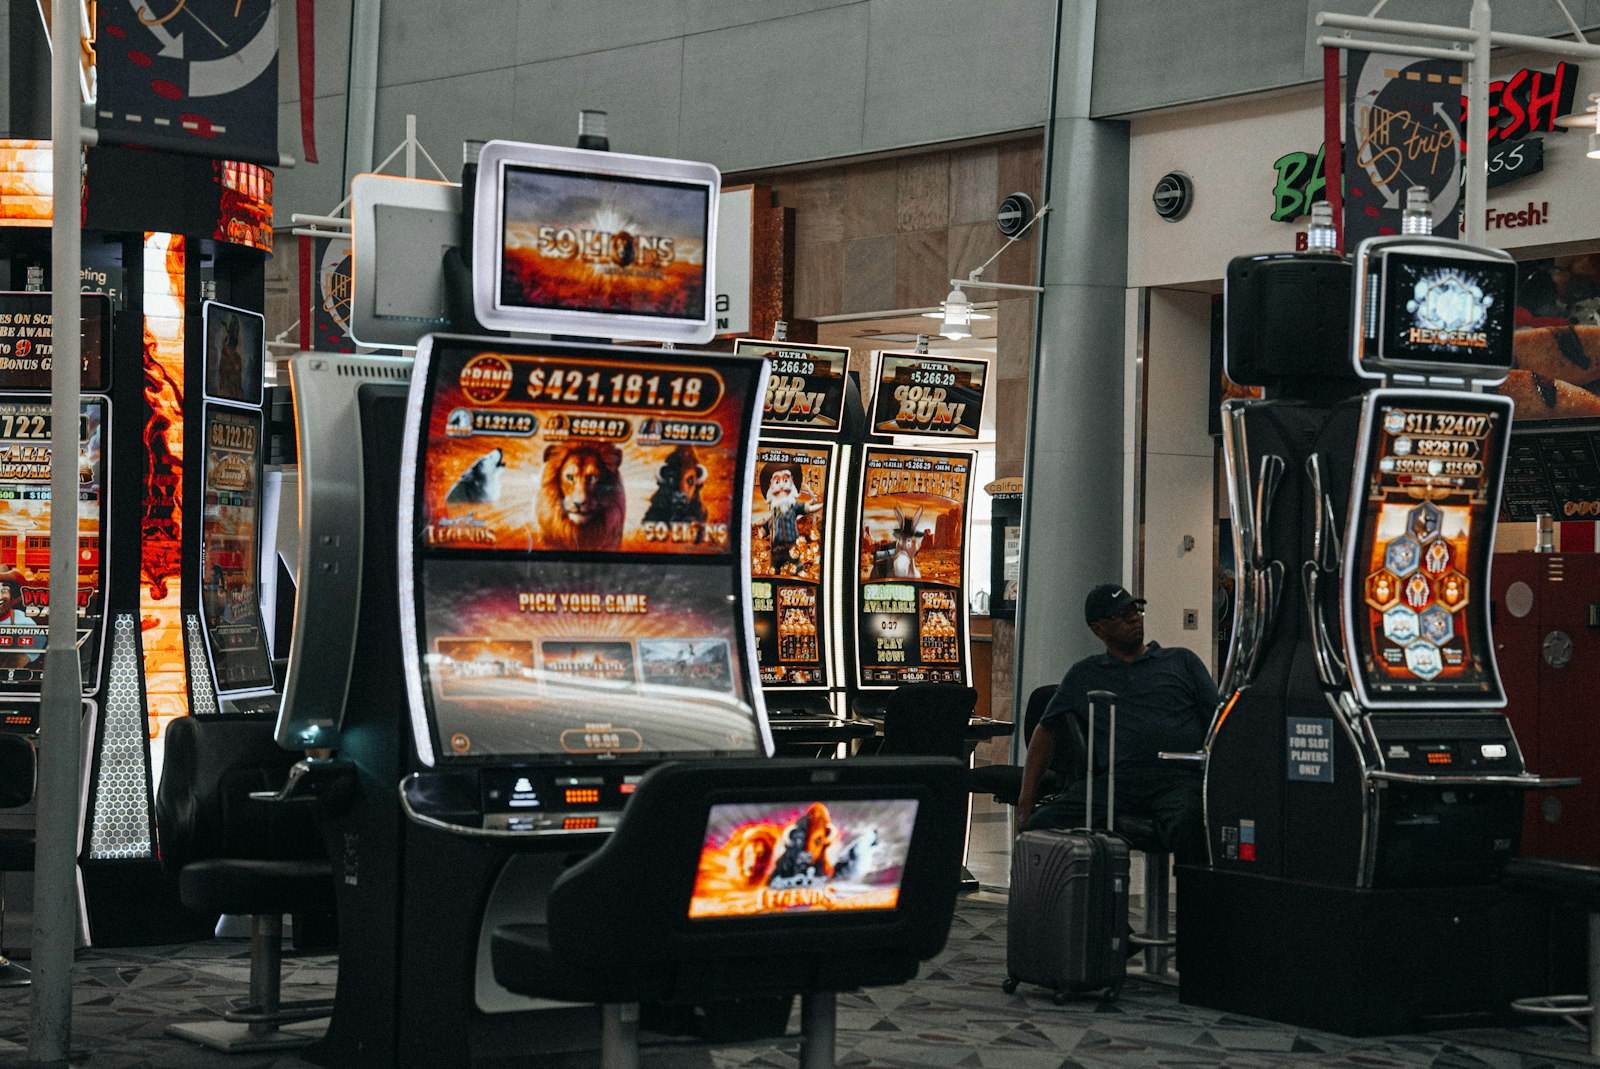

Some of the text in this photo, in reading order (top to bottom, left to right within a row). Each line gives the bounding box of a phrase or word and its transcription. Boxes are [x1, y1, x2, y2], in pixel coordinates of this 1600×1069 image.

[1357, 110, 1454, 187] Strip
[1486, 202, 1549, 231] Fresh!
[538, 226, 578, 260] 50
[14, 314, 31, 324] ON
[15, 339, 31, 357] 9
[779, 351, 808, 360] ULTRA
[0, 360, 38, 370] BONUS
[771, 360, 815, 375] 5,266.29
[921, 362, 949, 371] ULTRA
[460, 366, 513, 390] GRAND
[527, 367, 703, 408] $421,181.18
[894, 385, 947, 402] GOLD
[896, 400, 966, 424] RUN!
[519, 592, 647, 614] PICK YOUR GAME
[877, 638, 904, 650] PLAY
